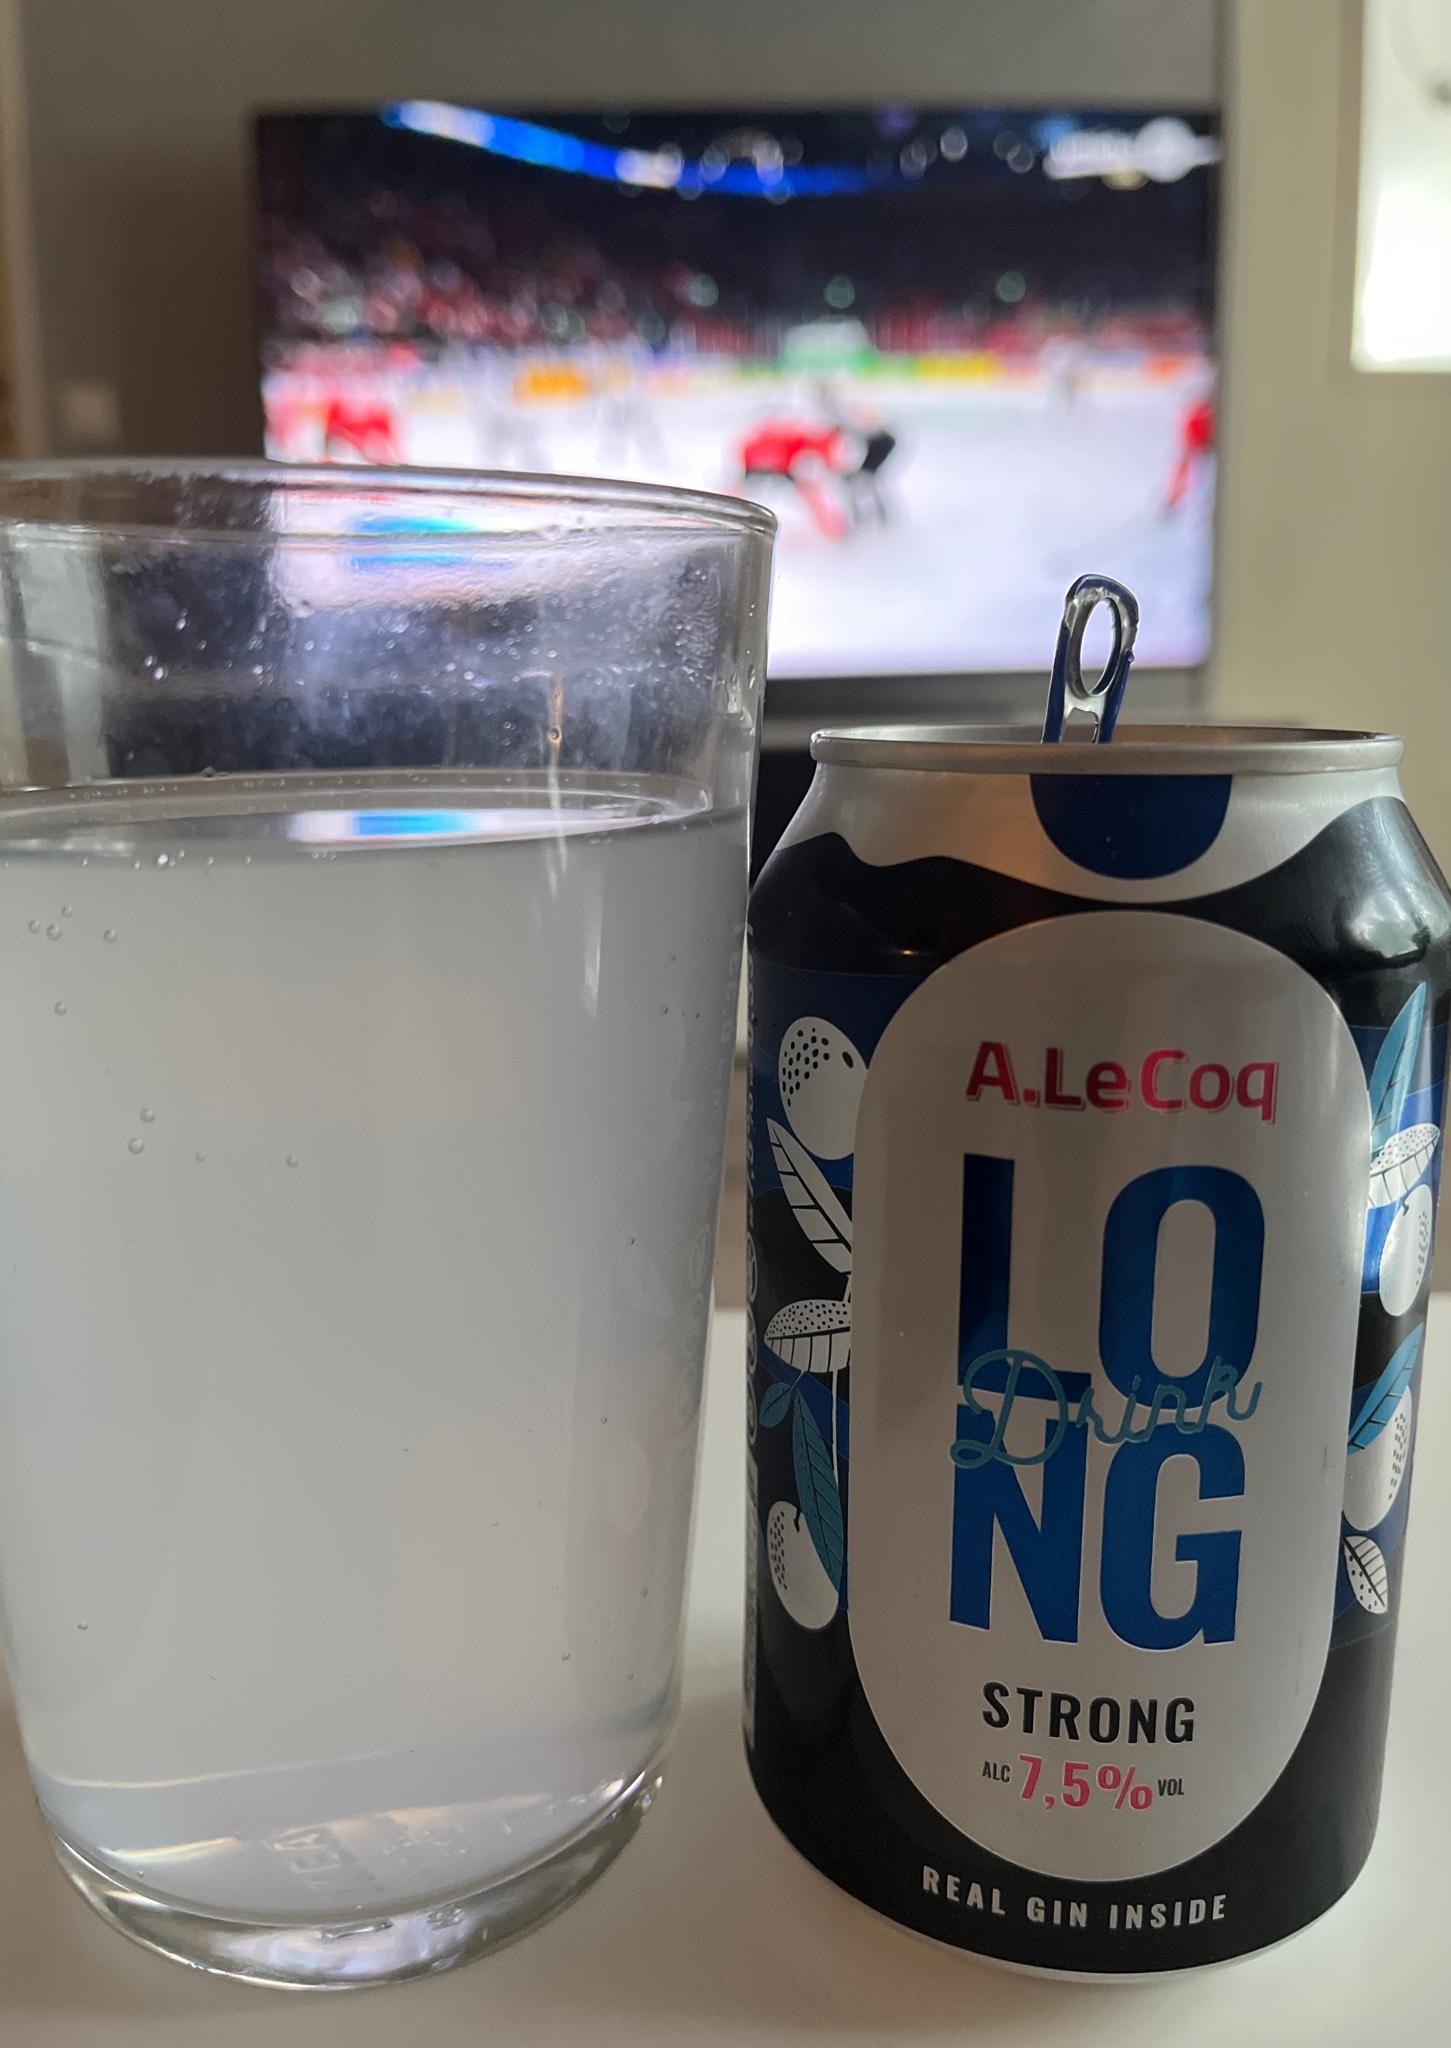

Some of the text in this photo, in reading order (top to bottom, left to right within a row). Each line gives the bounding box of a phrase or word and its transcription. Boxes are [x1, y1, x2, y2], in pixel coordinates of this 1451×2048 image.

[950, 1348, 1263, 1469] Drink
[982, 1681, 1195, 1744] STRONG
[982, 1754, 1184, 1811] ALC 7,5% VOL
[922, 1866, 1227, 1930] REAL GIN INSIDE
